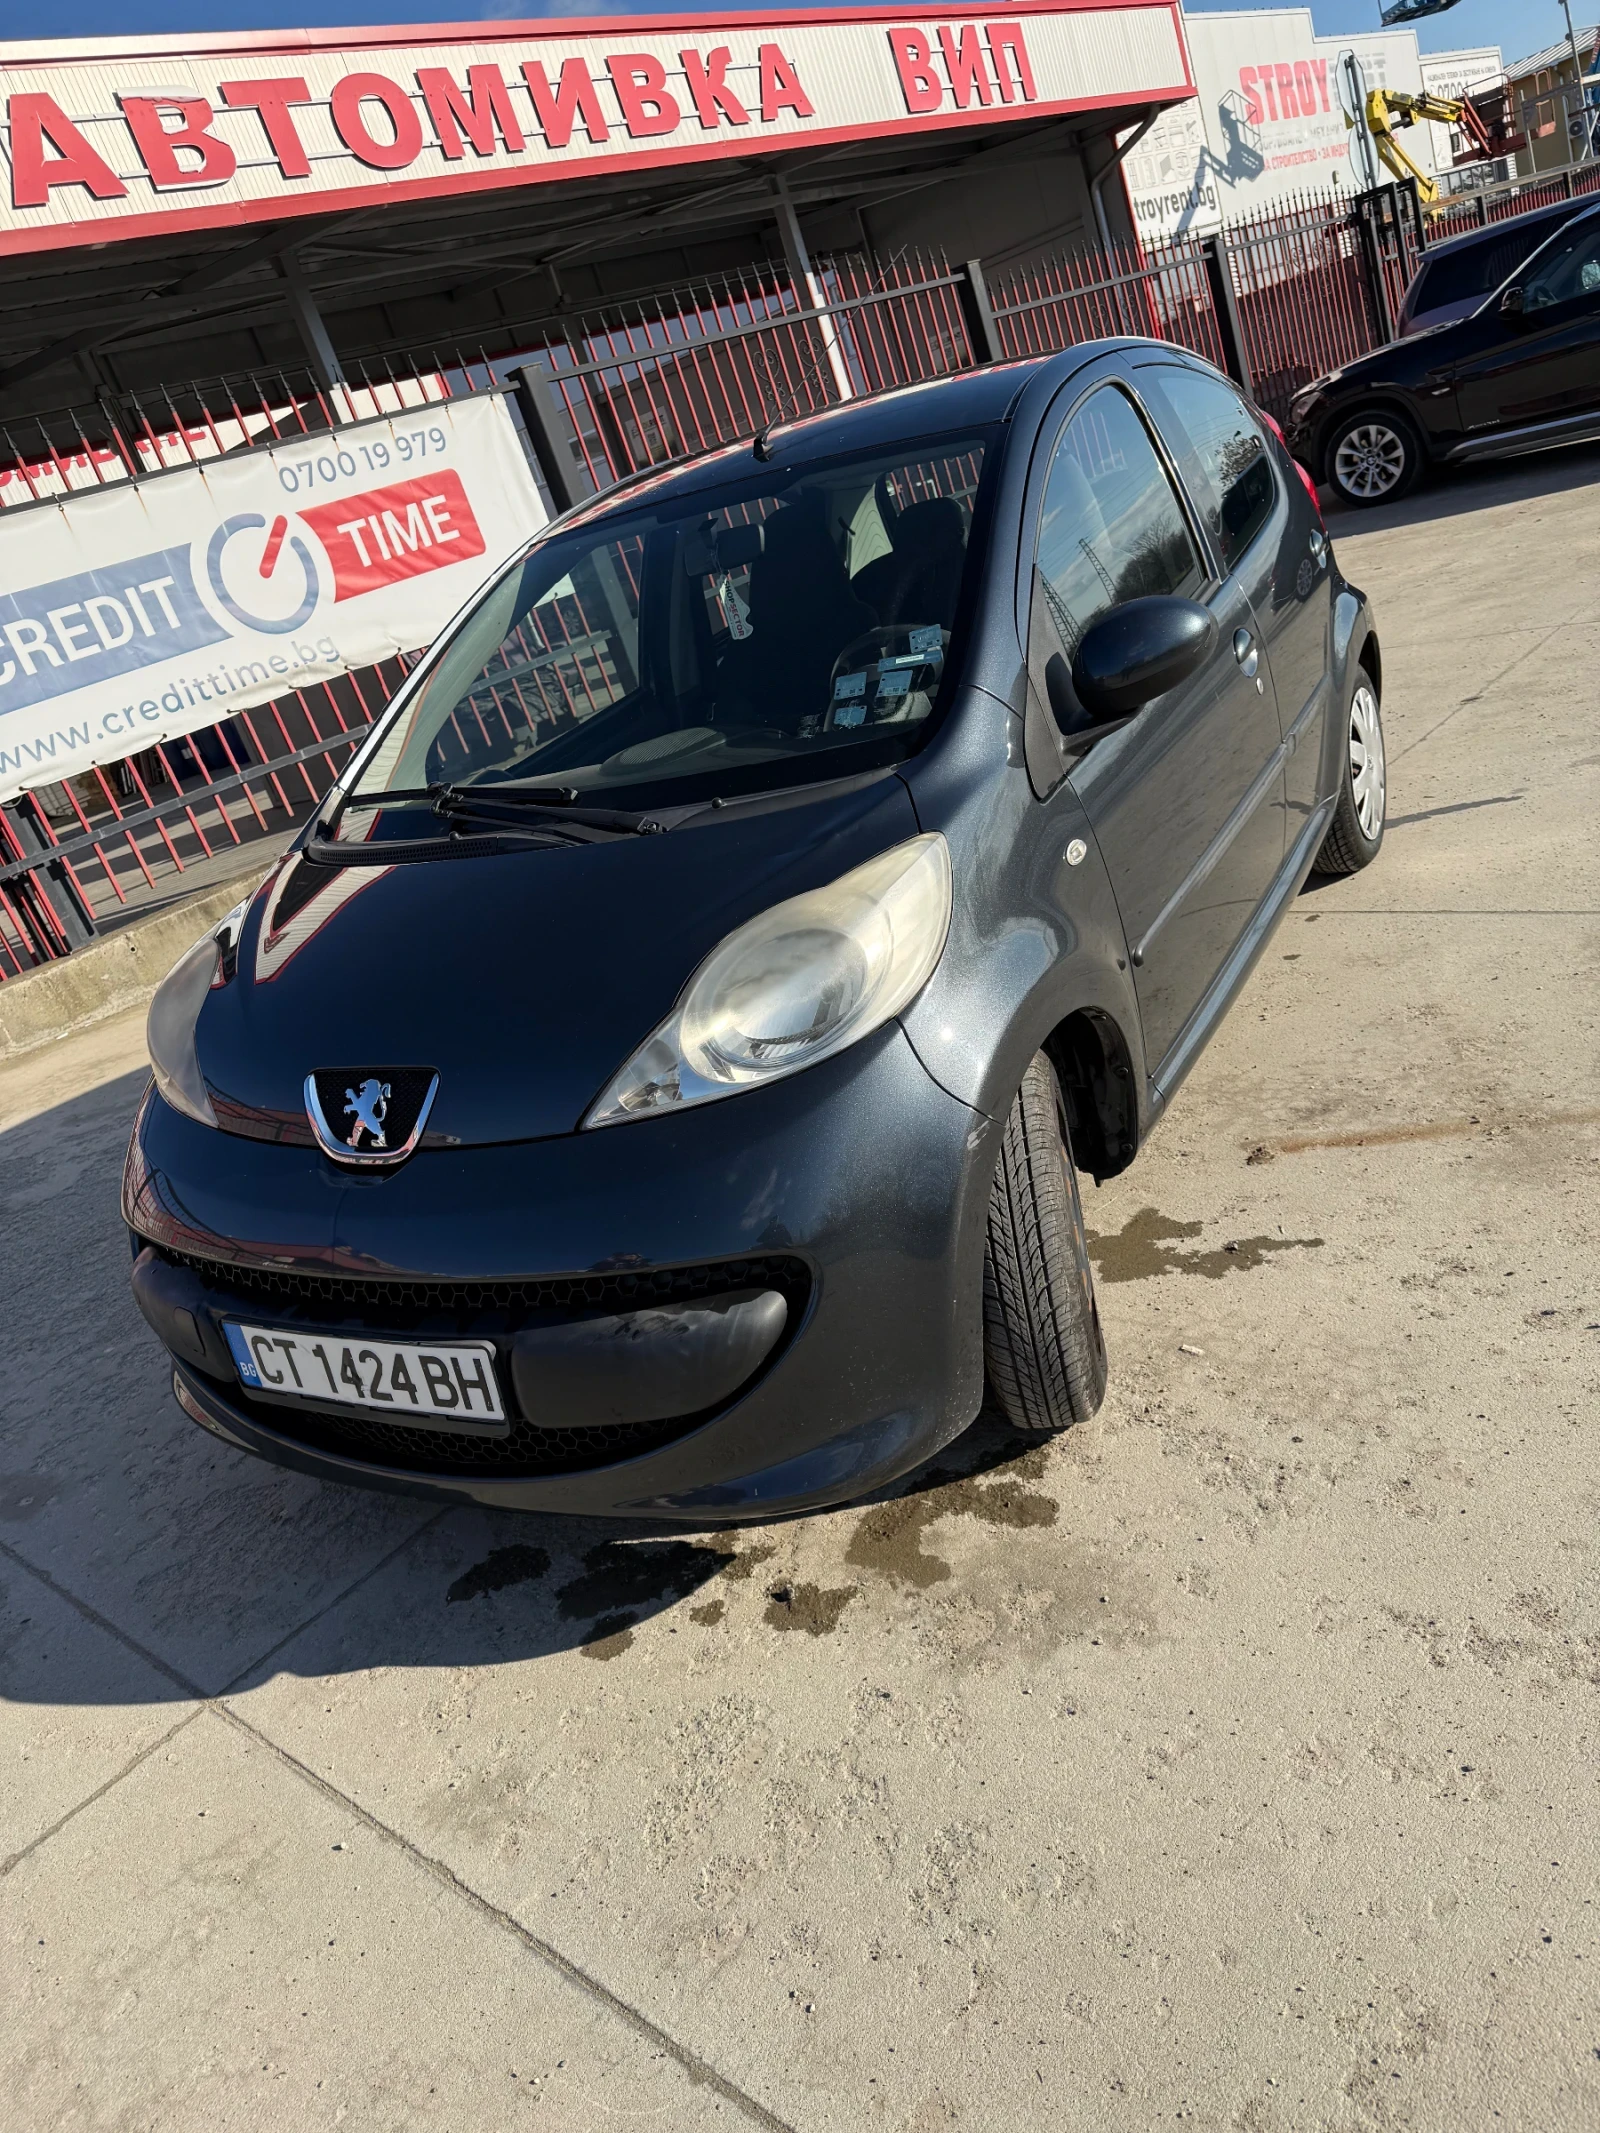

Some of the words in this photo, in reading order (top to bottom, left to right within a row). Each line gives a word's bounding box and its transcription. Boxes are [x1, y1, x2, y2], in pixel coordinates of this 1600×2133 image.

[10, 43, 815, 207] АВТОМИВКА
[887, 21, 1038, 114] ВИП
[278, 451, 357, 493] 0700
[359, 442, 391, 471] 19
[394, 427, 446, 462] 979
[336, 494, 461, 568] TIME
[0, 634, 341, 774] www.credittime.bg
[241, 1361, 258, 1378] BG
[251, 1335, 304, 1388] CT
[312, 1344, 420, 1405] 1424
[418, 1354, 496, 1413] BH
